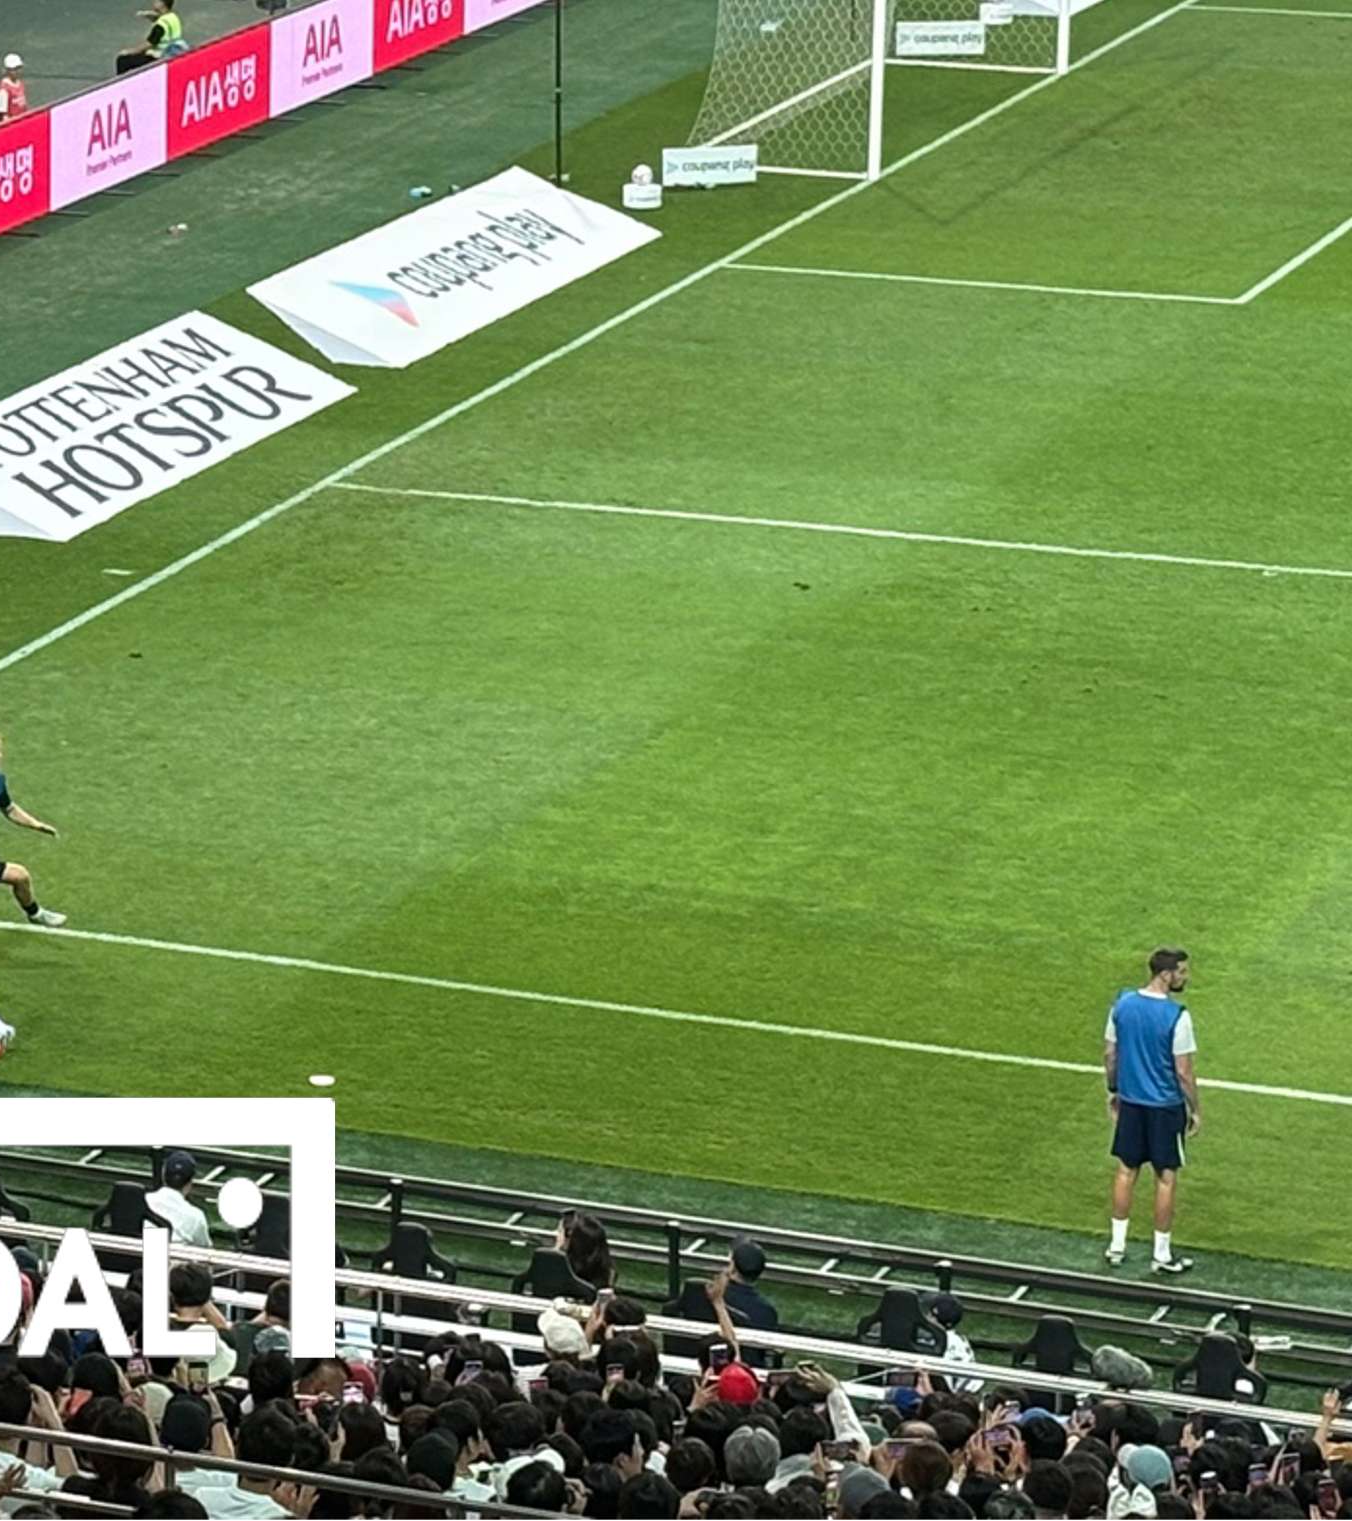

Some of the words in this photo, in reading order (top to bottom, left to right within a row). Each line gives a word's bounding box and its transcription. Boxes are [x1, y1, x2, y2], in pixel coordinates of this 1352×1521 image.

[302, 14, 342, 67] AIA
[87, 98, 132, 157] AIA
[181, 53, 256, 128] AIA생명
[386, 232, 540, 298] coupang
[476, 208, 585, 261] play
[11, 365, 313, 518] HOTSPUR
